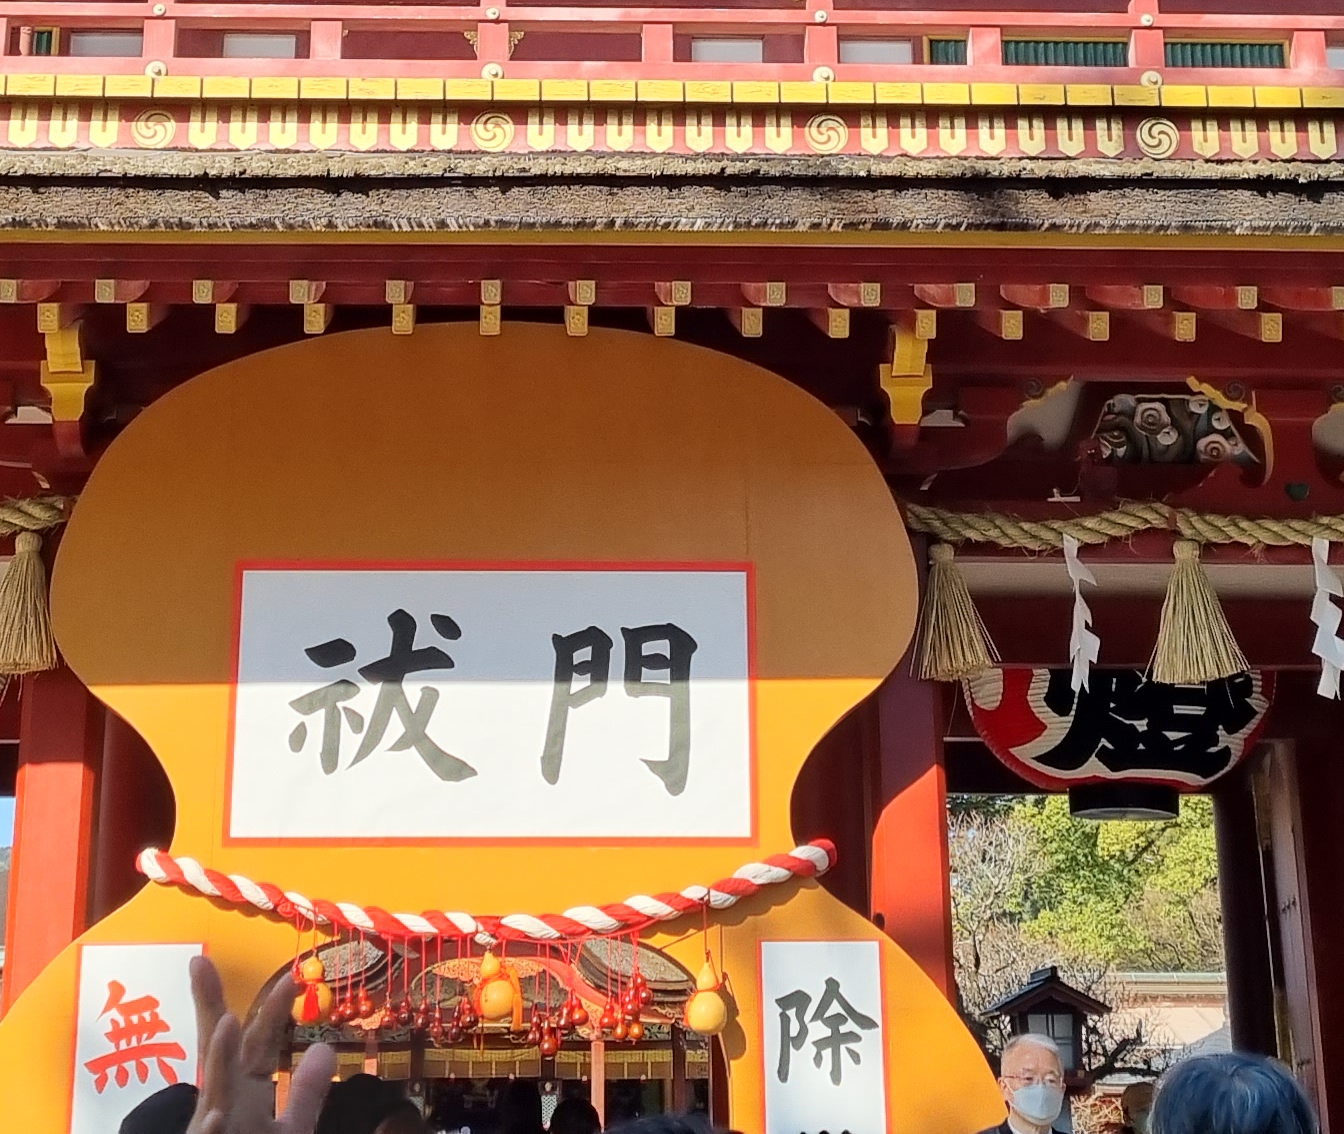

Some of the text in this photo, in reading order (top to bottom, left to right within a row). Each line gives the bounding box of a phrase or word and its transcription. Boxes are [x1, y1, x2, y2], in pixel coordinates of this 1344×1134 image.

[289, 608, 698, 797] 祓門
[83, 979, 187, 1095] 無
[774, 976, 880, 1134] 除
